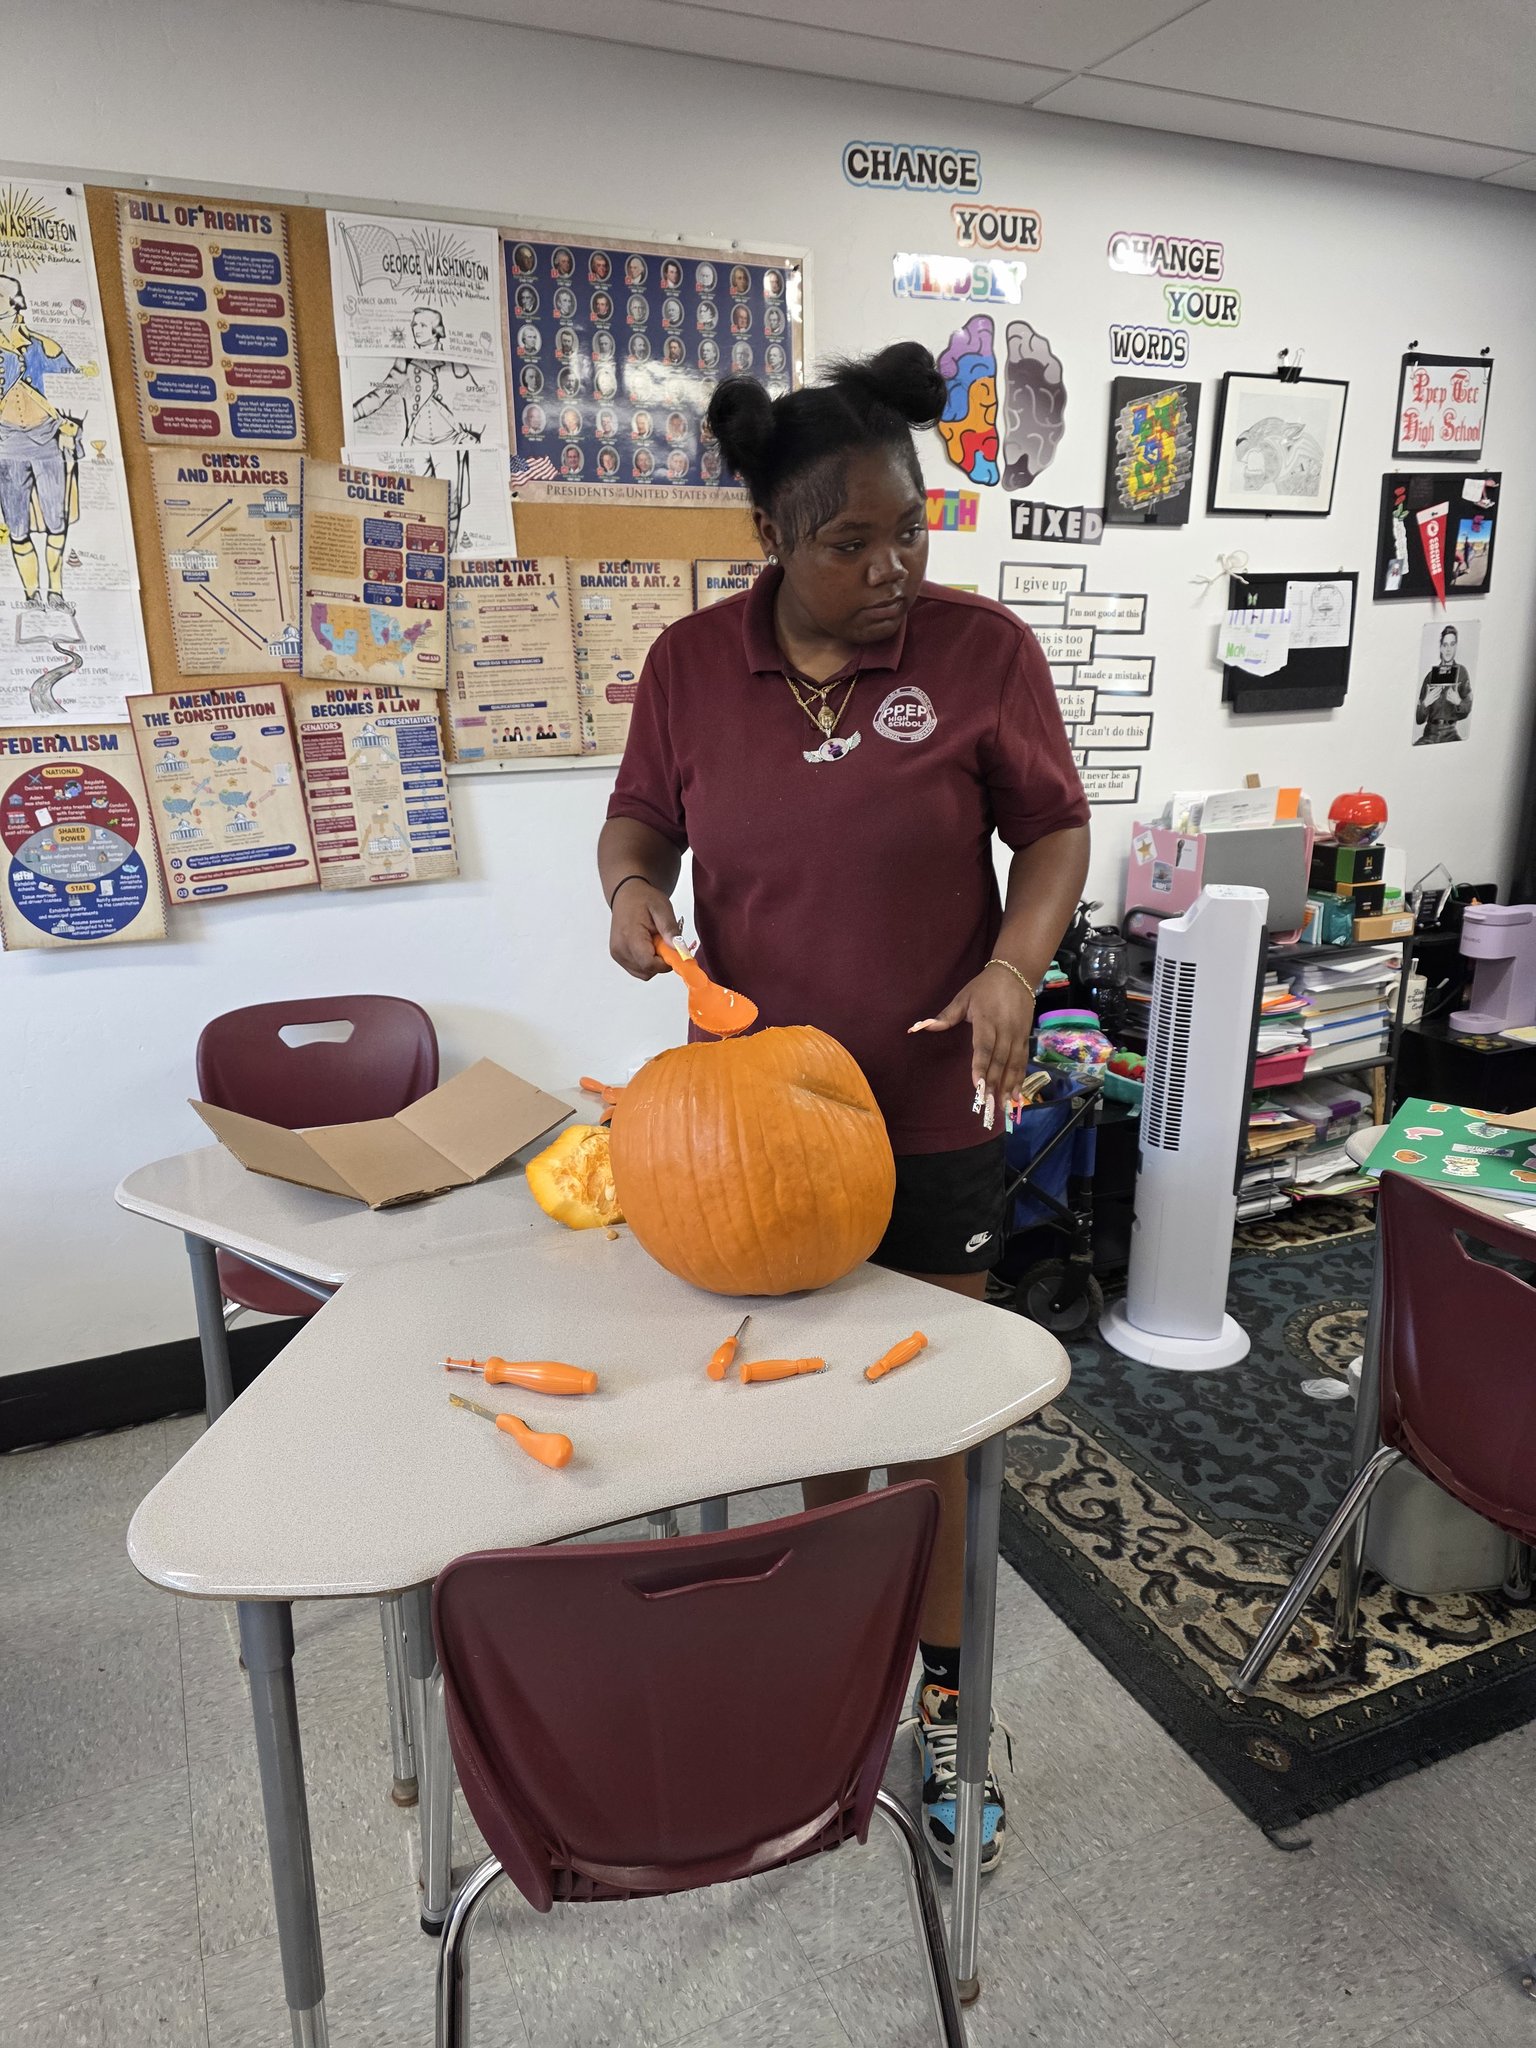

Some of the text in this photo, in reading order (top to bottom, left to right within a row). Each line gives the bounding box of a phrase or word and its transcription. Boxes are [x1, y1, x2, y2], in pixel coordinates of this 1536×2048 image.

[848, 148, 978, 188] CHANGE
[129, 200, 273, 235] BILL OF RIGHTS
[0, 214, 77, 242] WASHINGTON
[956, 210, 1038, 246] YOUR
[1112, 236, 1220, 275] CHANGE
[382, 254, 489, 282] GEORGE WASHINGTON
[1168, 290, 1237, 321] YOUR
[1112, 329, 1186, 362] WORDS
[1402, 407, 1483, 448] High School
[201, 453, 260, 469] CHECKS
[177, 468, 289, 485] AND BALANCES
[338, 468, 415, 492] ELECTORAL
[347, 485, 405, 505] COLLEGE
[546, 484, 615, 498] PRESIDENTS
[625, 487, 669, 499] UNITED
[672, 488, 707, 500] STATES
[926, 498, 976, 525] WTH
[1014, 505, 1101, 540] FIXED
[461, 559, 539, 574] LEGISLATIVE
[598, 562, 661, 575] EXECUTIVE
[727, 564, 764, 576] JUDICI
[450, 573, 555, 588] BRANCH & ART. 1
[580, 576, 681, 588] BRANCH & ART. 2
[706, 577, 749, 589] BRANCH
[1015, 576, 1067, 594] I give up
[1070, 608, 1140, 619] I'm not good at this
[1036, 629, 1083, 644] his is too
[1047, 646, 1082, 657] for me
[1078, 670, 1082, 678] I
[1083, 671, 1105, 679] made
[1115, 671, 1146, 680] mistake
[168, 691, 246, 710] AMENDING
[326, 687, 404, 703] HOW A BILL
[1059, 695, 1085, 705] ork is
[142, 702, 276, 728] THE CONSTITUTION
[311, 699, 421, 718] BECOMES A LAW
[883, 704, 927, 719] PPEP
[1063, 708, 1086, 719] ough
[302, 723, 339, 731] SENATORS
[377, 717, 435, 726] REPRESENTATIVES
[1080, 726, 1144, 736] I can't do this
[0, 734, 119, 755] FEDERALISM
[1073, 753, 1081, 761] rd
[1108, 781, 1124, 789] that
[175, 875, 185, 883] 02
[178, 889, 188, 897] 03
